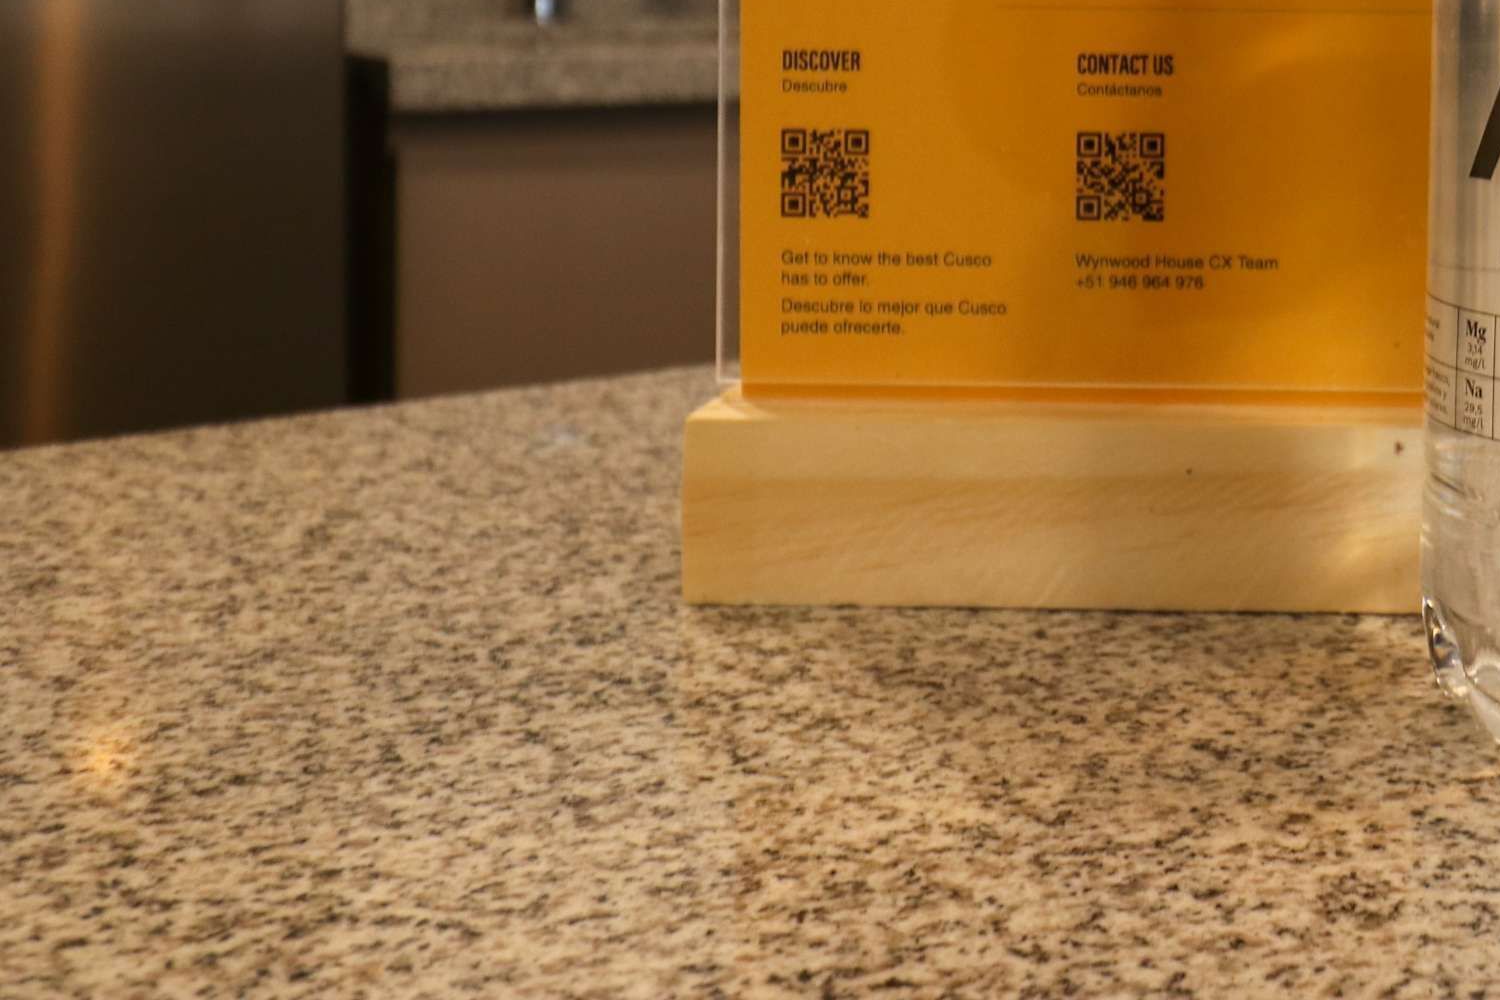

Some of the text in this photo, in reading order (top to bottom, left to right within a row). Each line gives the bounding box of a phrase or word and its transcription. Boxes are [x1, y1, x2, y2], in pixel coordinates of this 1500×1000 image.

[782, 49, 861, 72] DISCOVER
[1076, 52, 1175, 77] CONTACT US
[781, 78, 849, 95] Descubre
[780, 249, 993, 268] Get to know the best Cusco
[1074, 253, 1279, 272] Wynwood House CX Team
[780, 269, 809, 286] has
[813, 272, 828, 286] to
[781, 298, 1008, 319] Descubre lo mejor que Cusco
[780, 318, 829, 337] puede
[1466, 320, 1487, 344] Mg
[1465, 378, 1482, 399] Na
